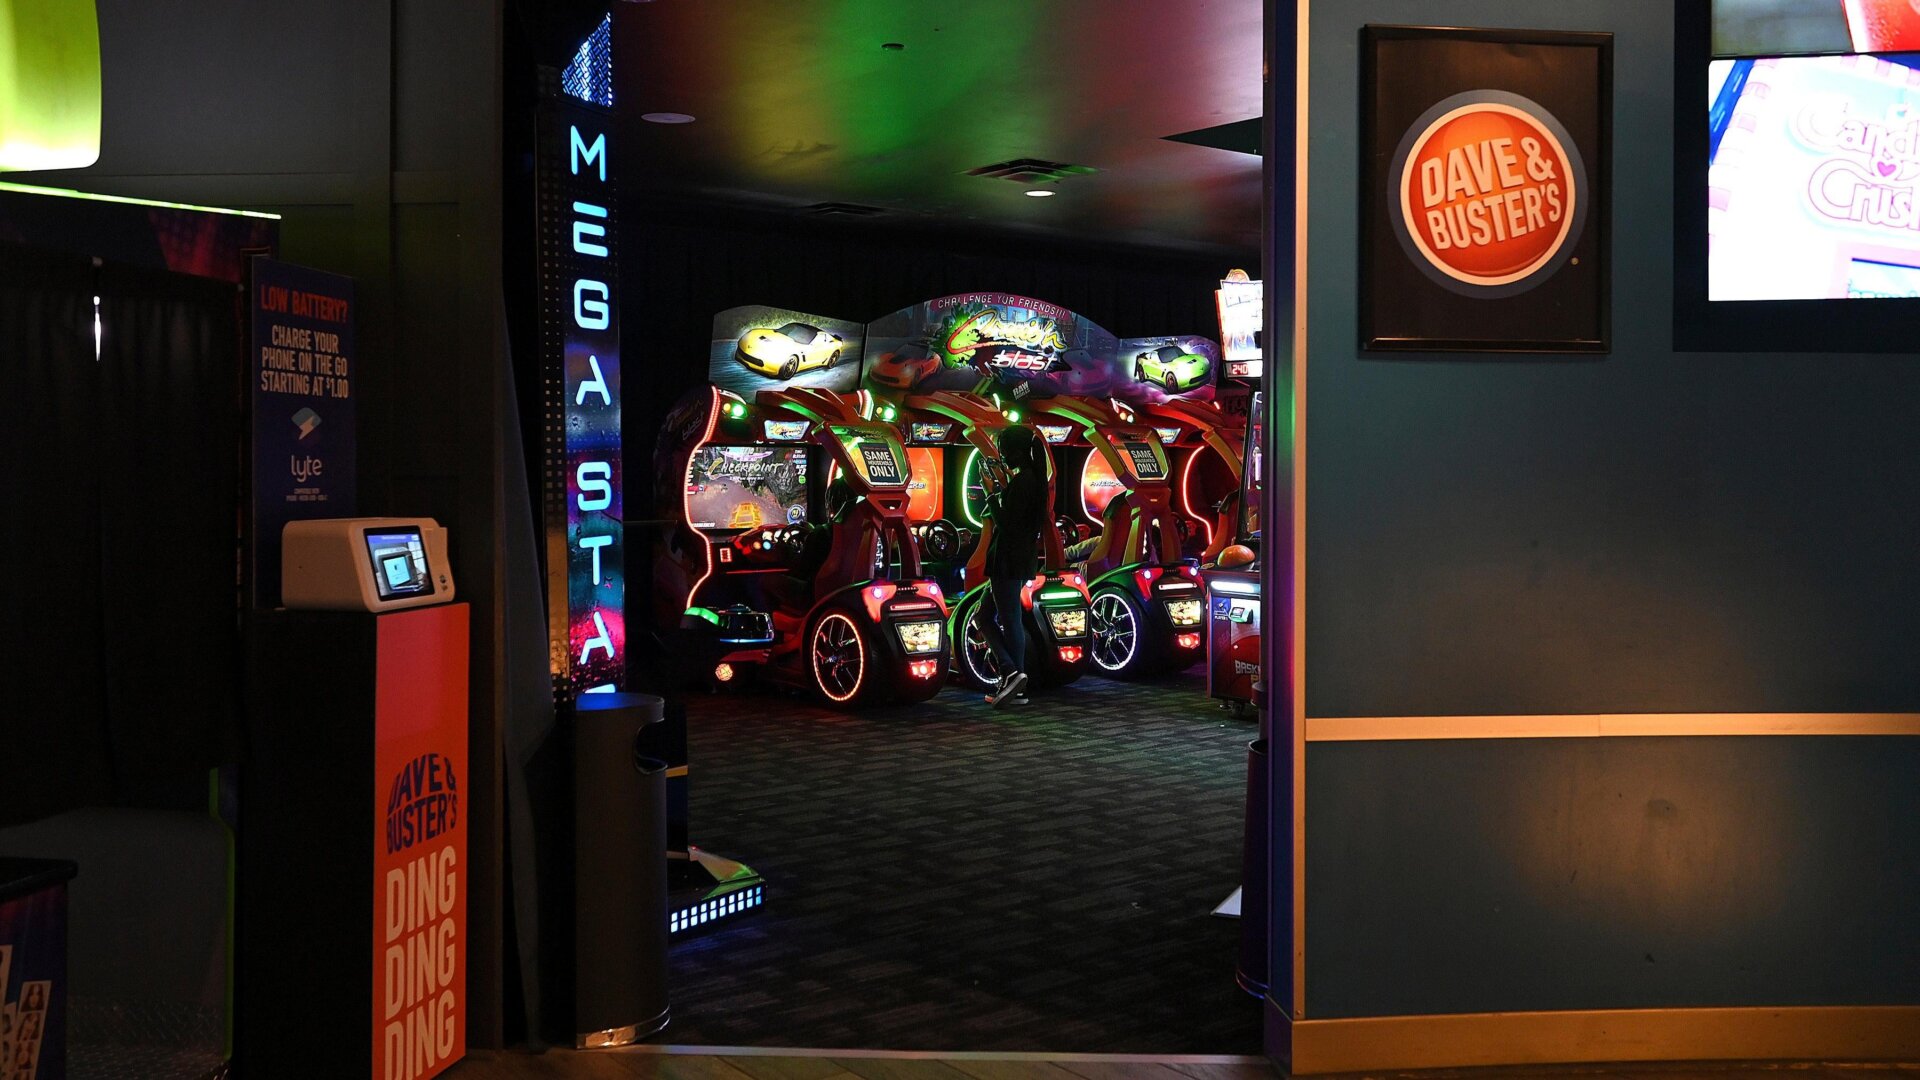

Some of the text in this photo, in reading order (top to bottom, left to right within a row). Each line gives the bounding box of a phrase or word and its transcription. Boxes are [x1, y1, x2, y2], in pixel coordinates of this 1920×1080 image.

[1421, 136, 1556, 208] DAVE &
[1426, 183, 1562, 250] BUSTER'S
[261, 284, 348, 323] LOW BATTERY?
[938, 295, 992, 309] CHALLENGE
[1018, 298, 1066, 319] FRIENDS!!!
[272, 324, 339, 354] CHARGE YOUR
[262, 347, 347, 377] PHONE ON THE GO
[1232, 364, 1248, 375] 240
[261, 370, 348, 399] STARTING AT $1.00
[291, 455, 323, 483] lyte
[864, 451, 892, 461] SAME
[1130, 450, 1154, 459] SAME
[1136, 462, 1158, 473] ONLY
[870, 466, 896, 477] ONLY
[388, 753, 457, 817] DAVE &
[386, 794, 457, 855] BUSTER'S
[386, 845, 456, 943] DING
[385, 917, 456, 1021] DING
[384, 989, 455, 1080] DING
